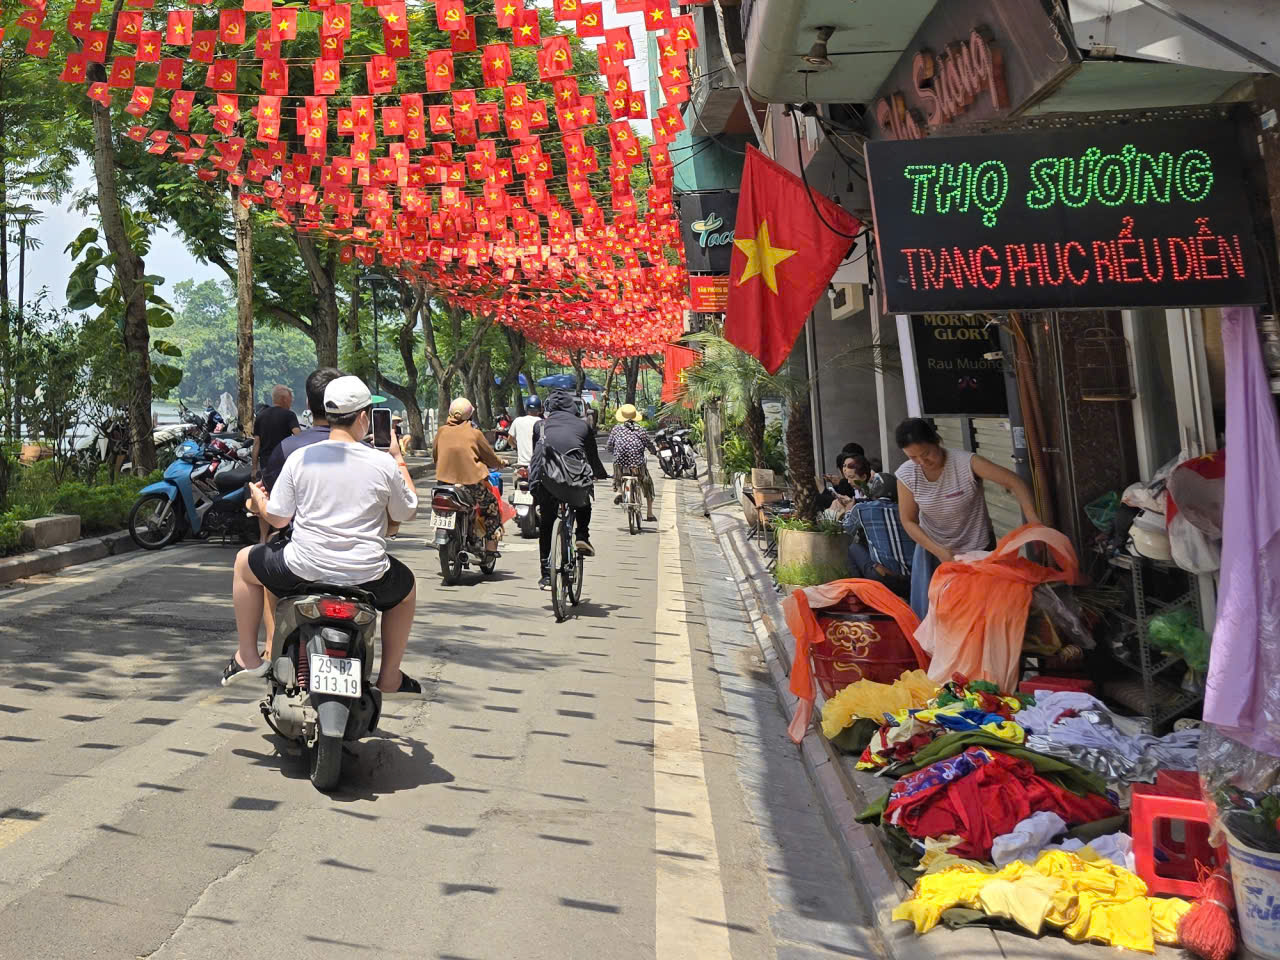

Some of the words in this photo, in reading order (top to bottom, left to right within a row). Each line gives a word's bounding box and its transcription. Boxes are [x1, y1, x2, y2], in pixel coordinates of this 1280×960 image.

[904, 160, 1009, 228] THỌ
[1025, 144, 1214, 209] SƯƠNG
[900, 244, 1002, 291] TRANG
[1167, 217, 1246, 282] DIỄN
[923, 312, 986, 326] MORNIN
[934, 328, 989, 340] GLORY
[927, 358, 953, 369] Rau
[318, 657, 353, 677] 29-B2
[314, 674, 358, 695] 313.19
